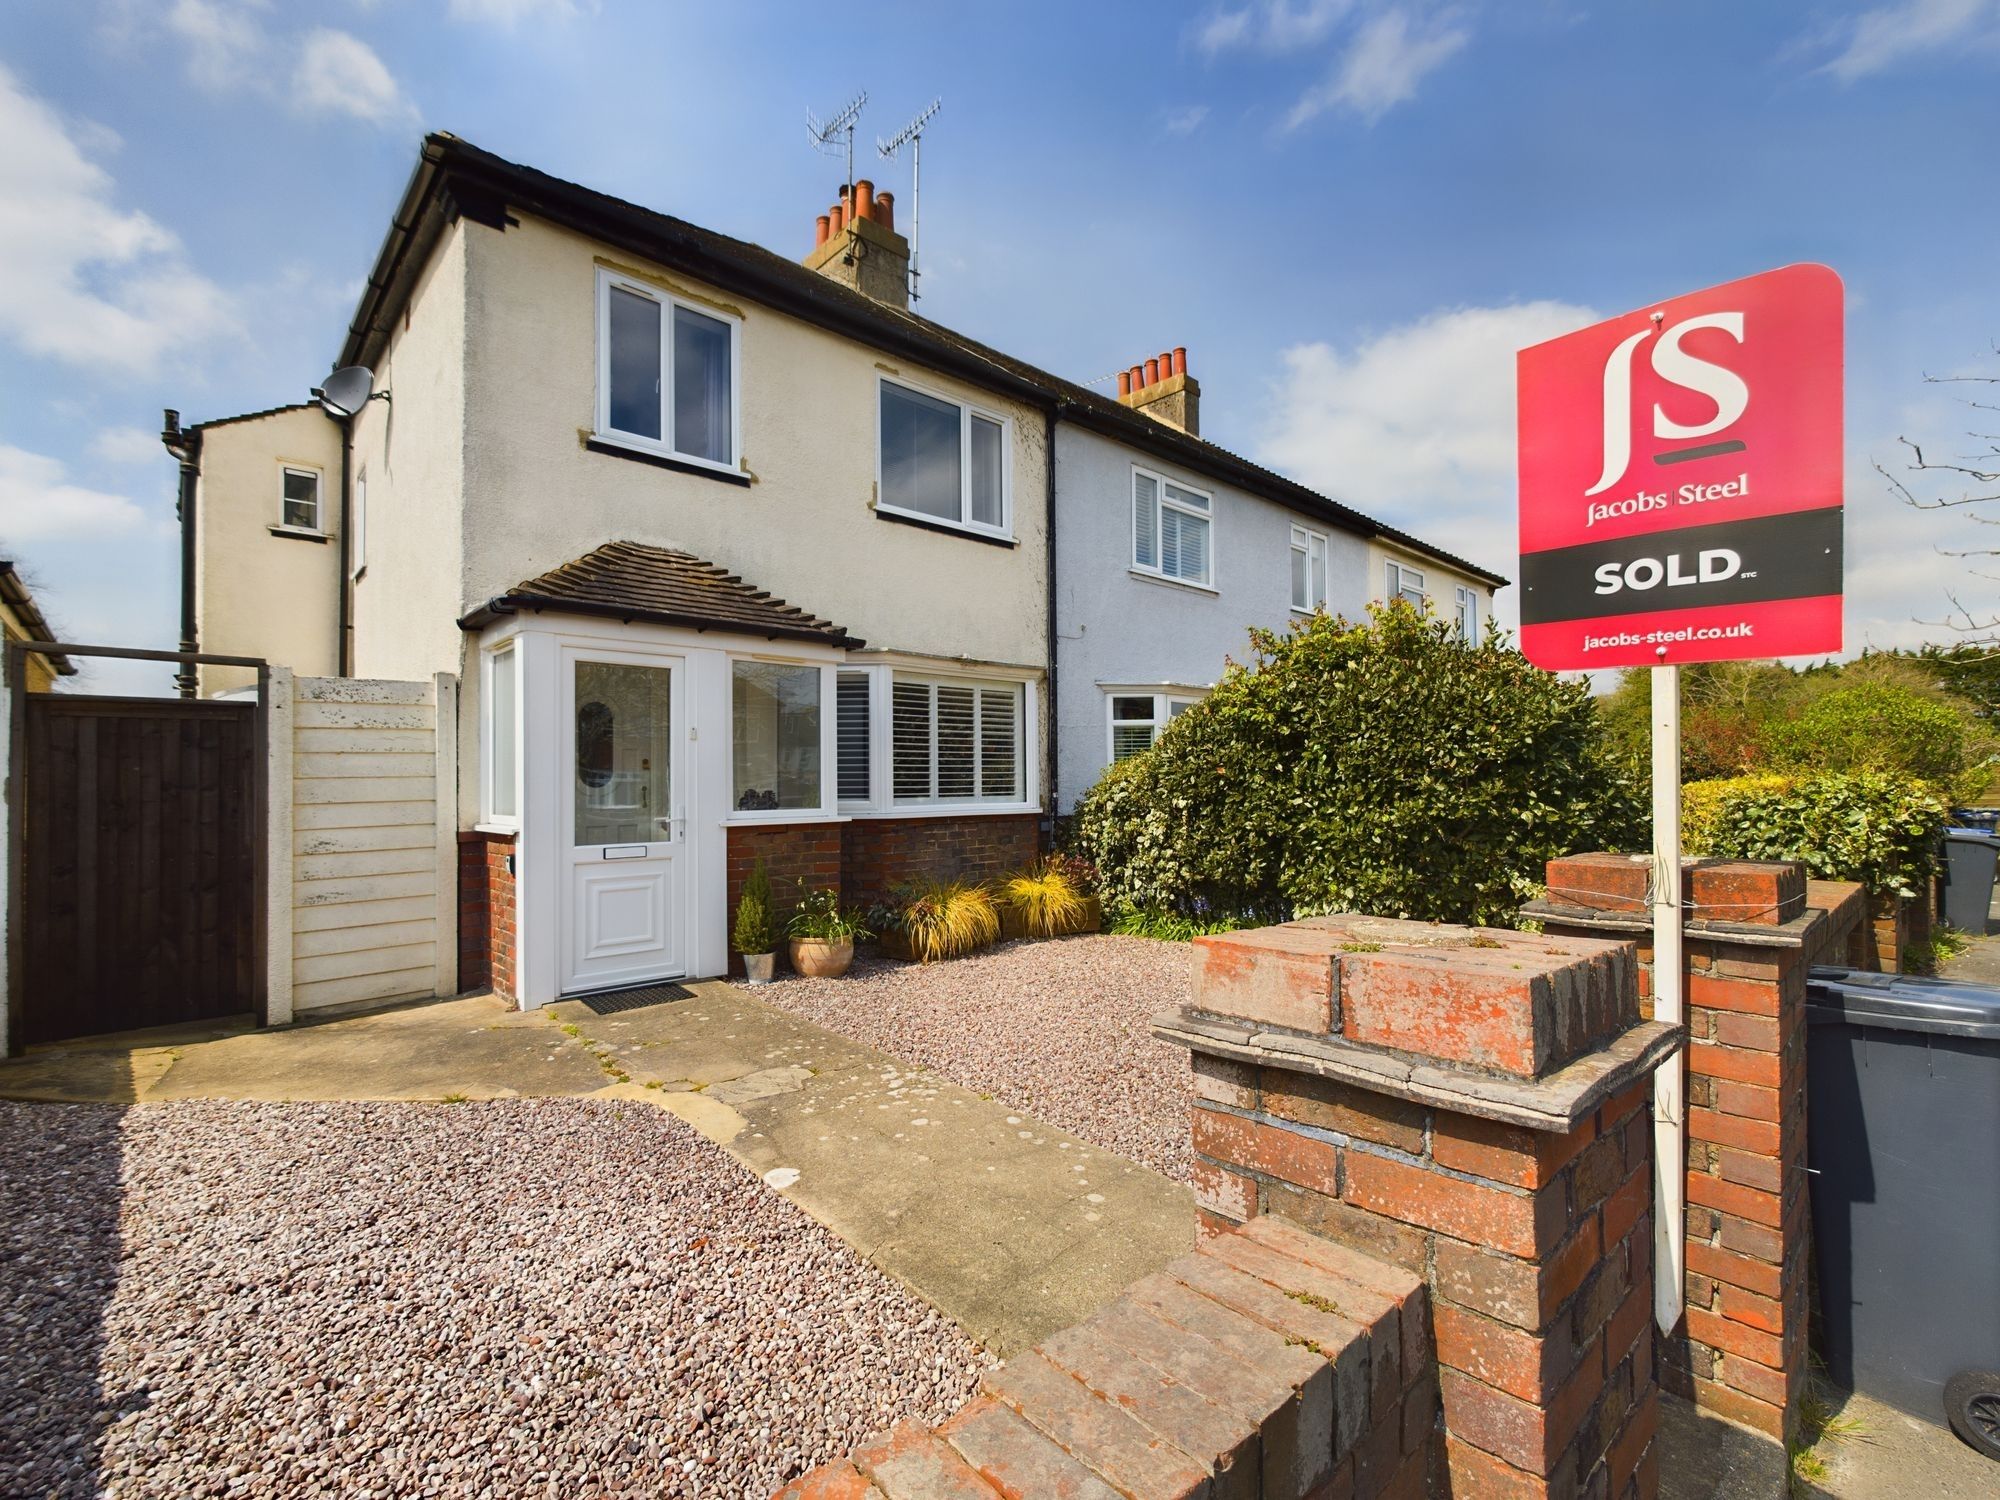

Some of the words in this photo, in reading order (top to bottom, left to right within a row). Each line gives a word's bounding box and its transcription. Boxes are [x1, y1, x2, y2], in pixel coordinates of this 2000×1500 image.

[1584, 312, 1749, 496] JS
[1586, 491, 1667, 527] Jacobs
[1678, 474, 1748, 506] Steel
[1594, 548, 1740, 595] SOLD
[1740, 570, 1757, 580] STC
[1583, 623, 1753, 652] jacobs-steel.co.uk
